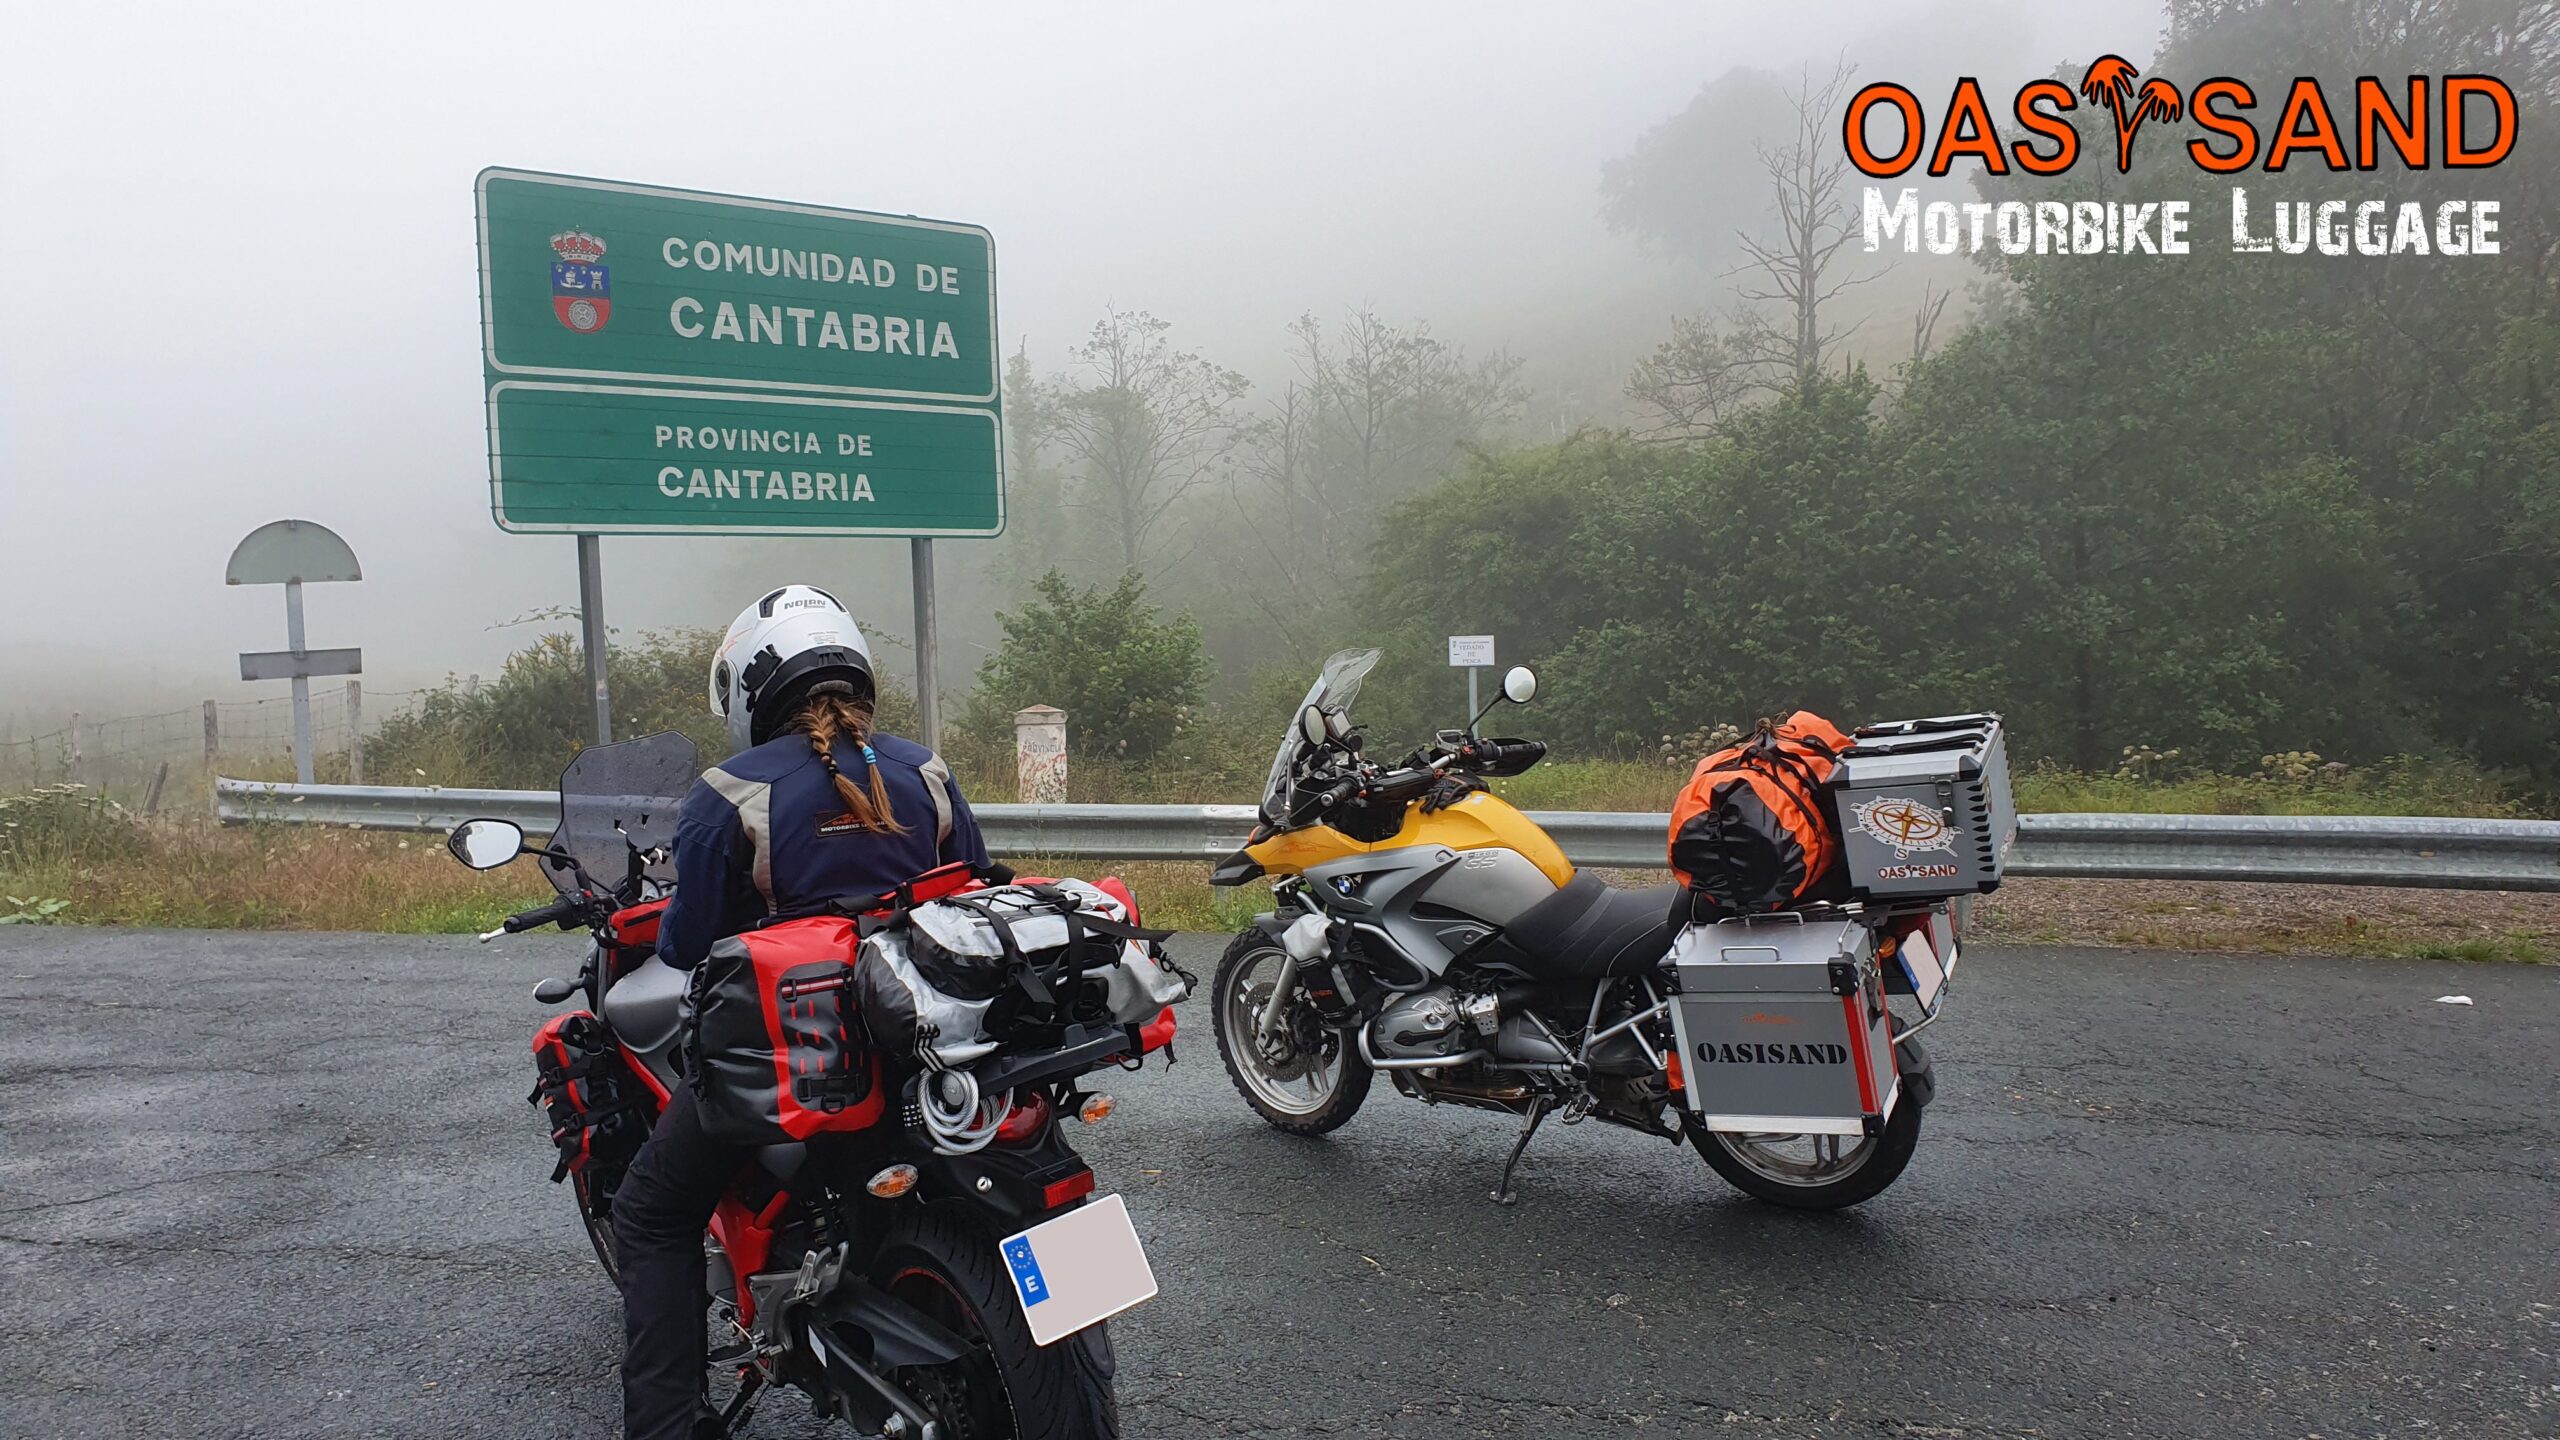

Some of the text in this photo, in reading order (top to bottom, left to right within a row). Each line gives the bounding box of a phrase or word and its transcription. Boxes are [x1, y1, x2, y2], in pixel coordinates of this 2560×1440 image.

[662, 236, 961, 295] COMUNIDAD DE
[669, 296, 961, 359] CANTABRIA
[655, 426, 873, 456] PROVINCIA DE
[657, 467, 876, 502] CANTABRIA
[784, 599, 826, 609] NOLAN
[1896, 848, 1908, 859] S
[1697, 1042, 1847, 1065] OASISAND
[1024, 1275, 1040, 1293] E
